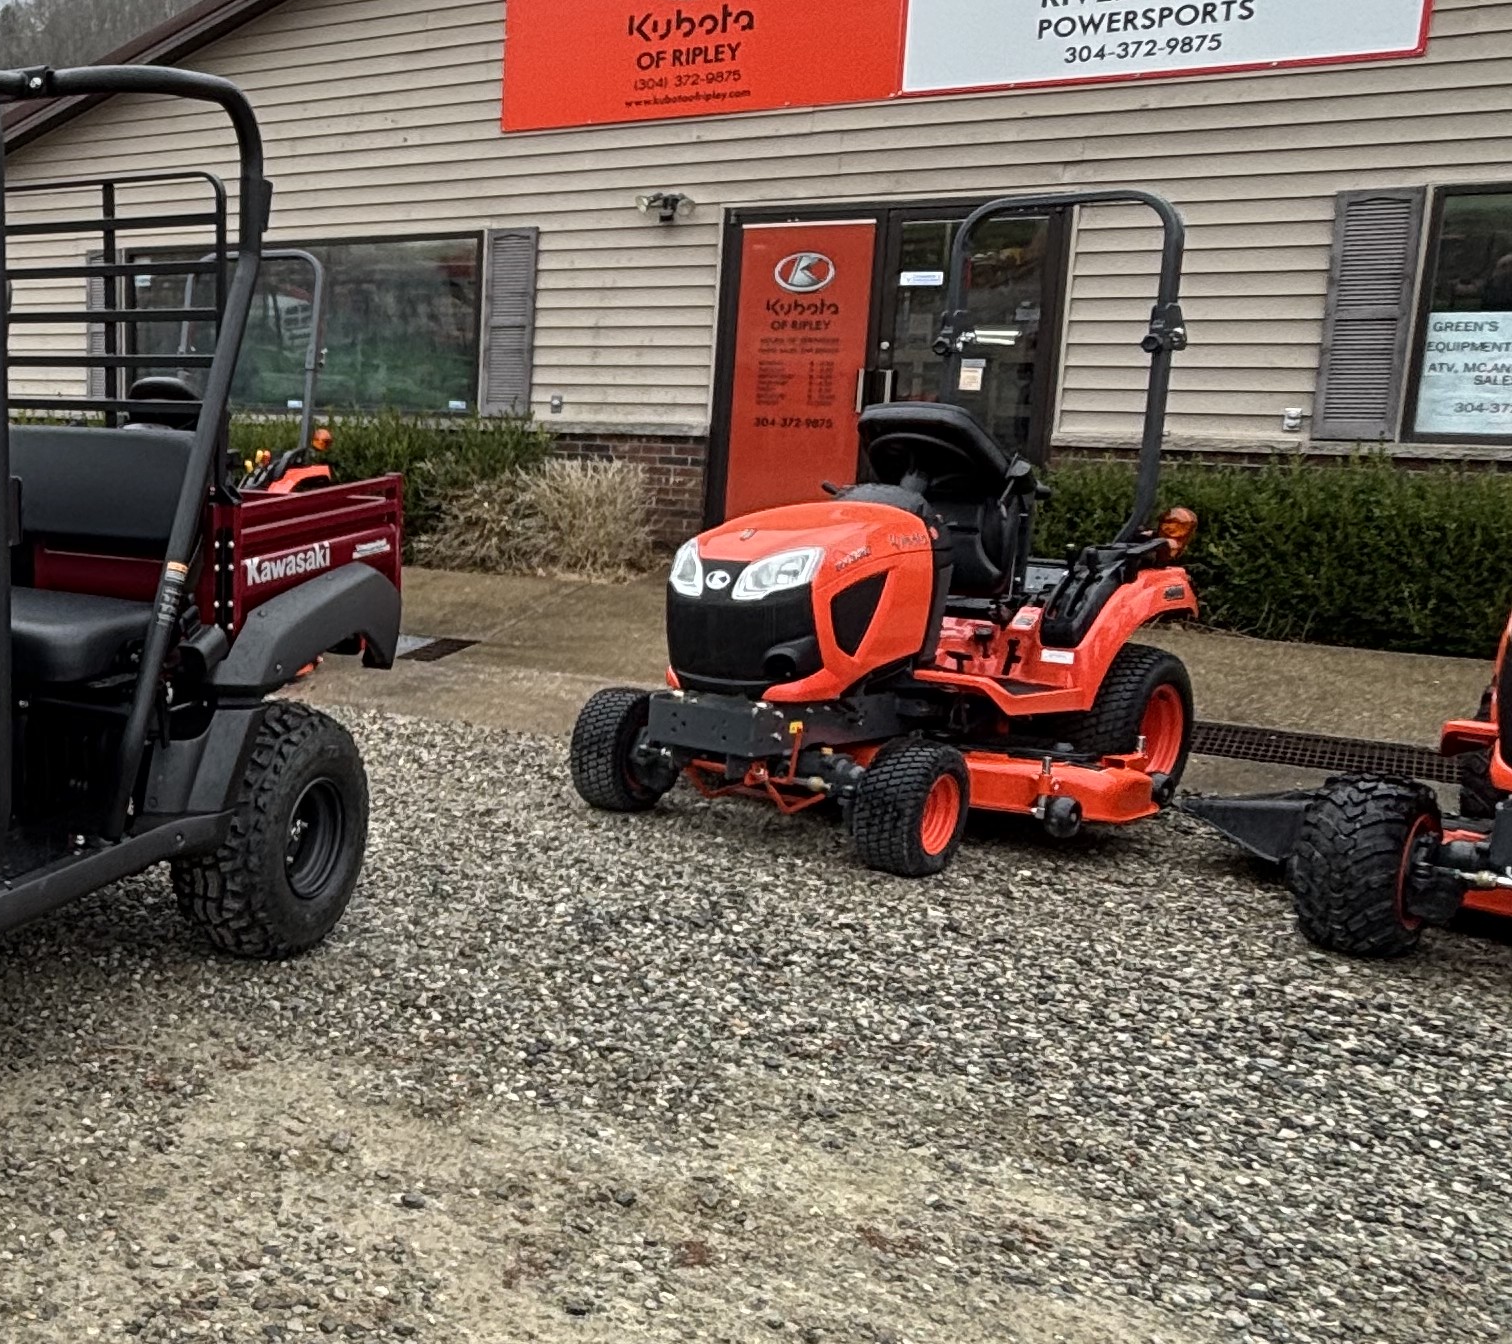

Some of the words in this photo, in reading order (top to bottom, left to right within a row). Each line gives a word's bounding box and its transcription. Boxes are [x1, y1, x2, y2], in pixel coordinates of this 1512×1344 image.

[628, 3, 754, 42] Kubota
[636, 50, 667, 71] OF
[672, 42, 742, 67] RIPLEY
[1064, 33, 1223, 64] 304-372-9875
[633, 76, 668, 91] (304)
[674, 69, 742, 87] 372-9875
[765, 298, 839, 316] Kubota
[770, 319, 787, 331] OF
[791, 319, 831, 331] RIPLEY
[1433, 320, 1500, 332] GREEN'S
[1426, 341, 1512, 353] EQUIPMENT
[1453, 402, 1512, 414] 304-37
[244, 540, 331, 586] Kawasaki
